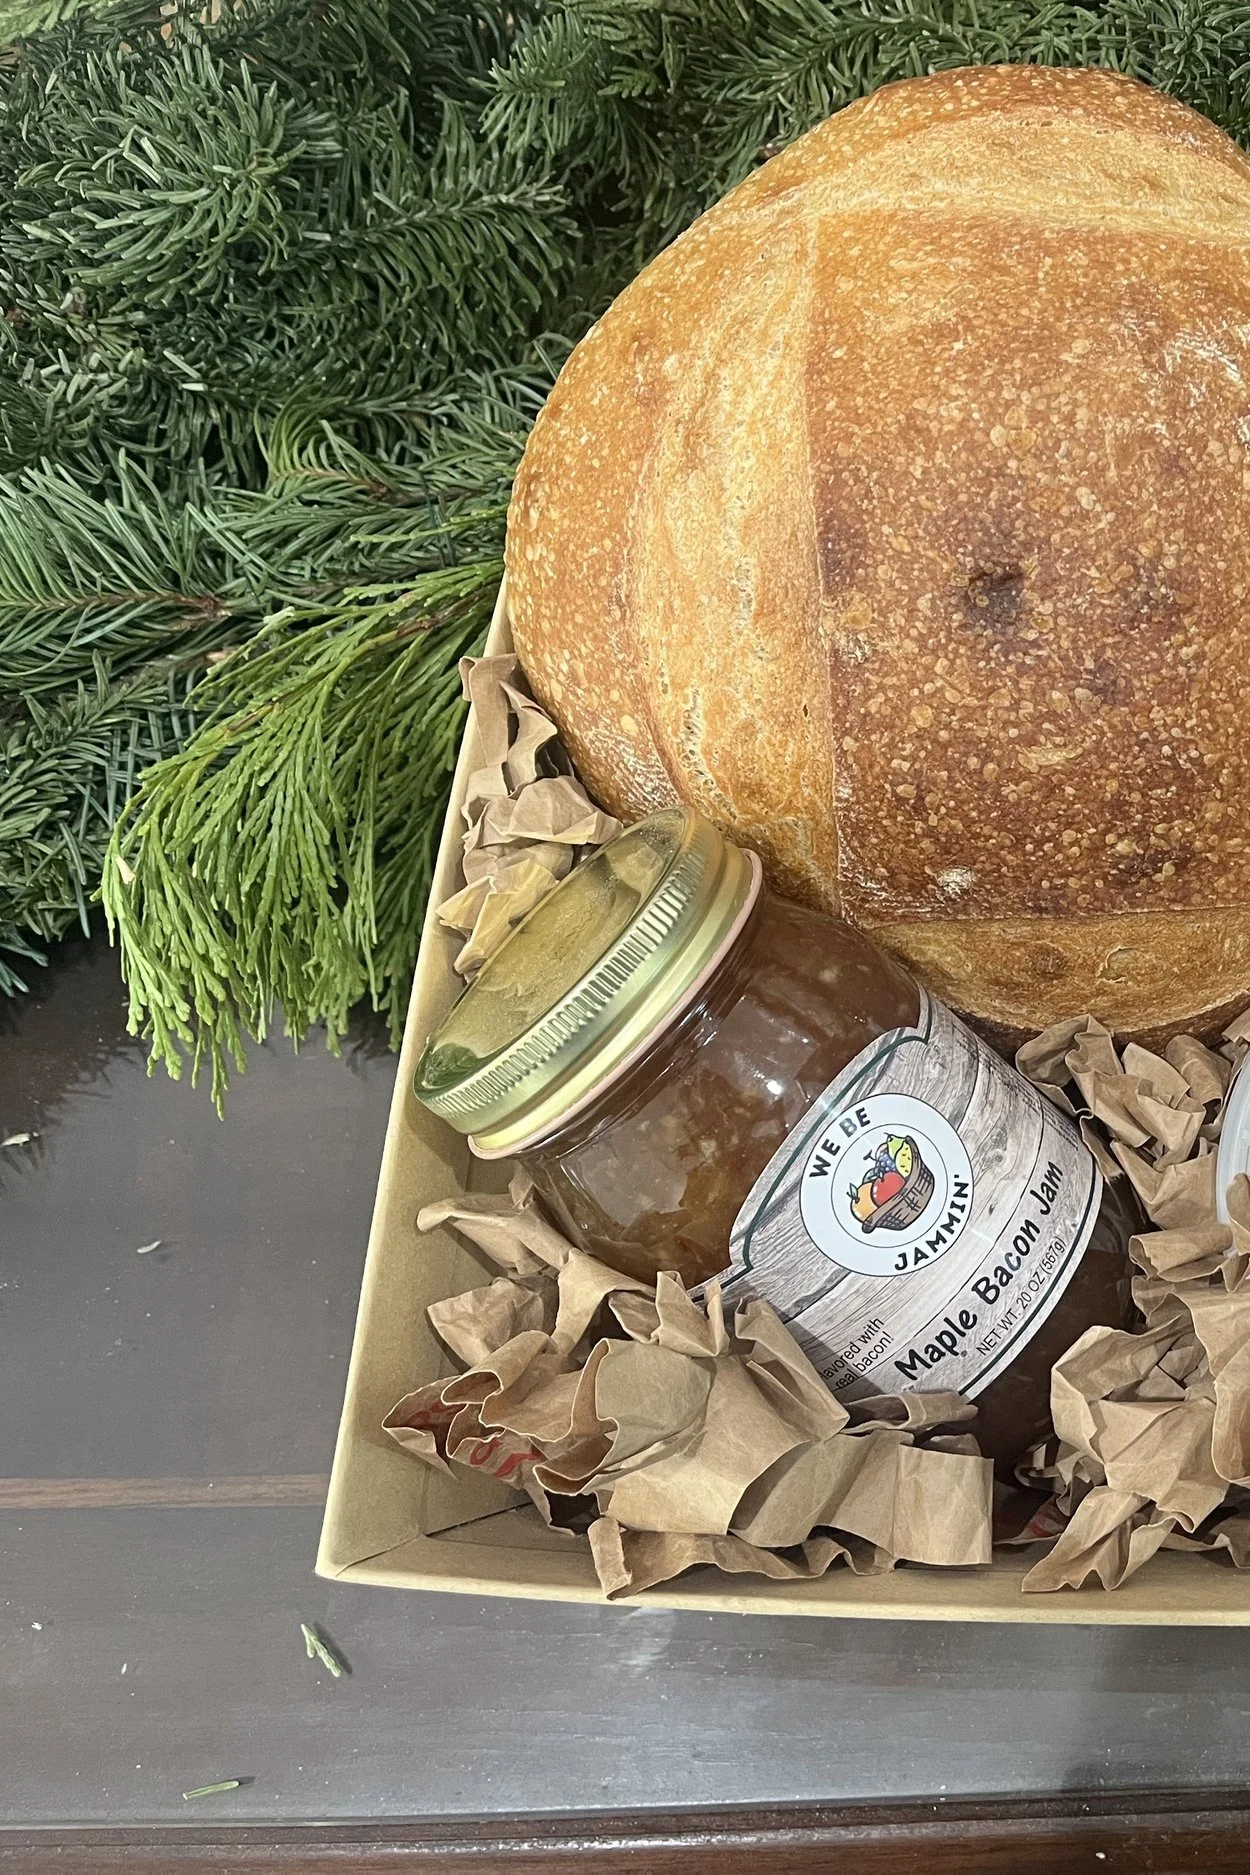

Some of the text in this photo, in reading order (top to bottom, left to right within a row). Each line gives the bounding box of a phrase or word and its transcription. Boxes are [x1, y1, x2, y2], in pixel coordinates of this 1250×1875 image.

[809, 1106, 871, 1179] WE BE
[894, 1174, 970, 1271] JAMMIN'
[894, 1161, 1064, 1380] Maple Bacon Jam
[976, 1236, 1067, 1356] NET WT. 20 OZ (567g)
[817, 1317, 885, 1380] lavored with
[835, 1331, 895, 1388] real bacon!
